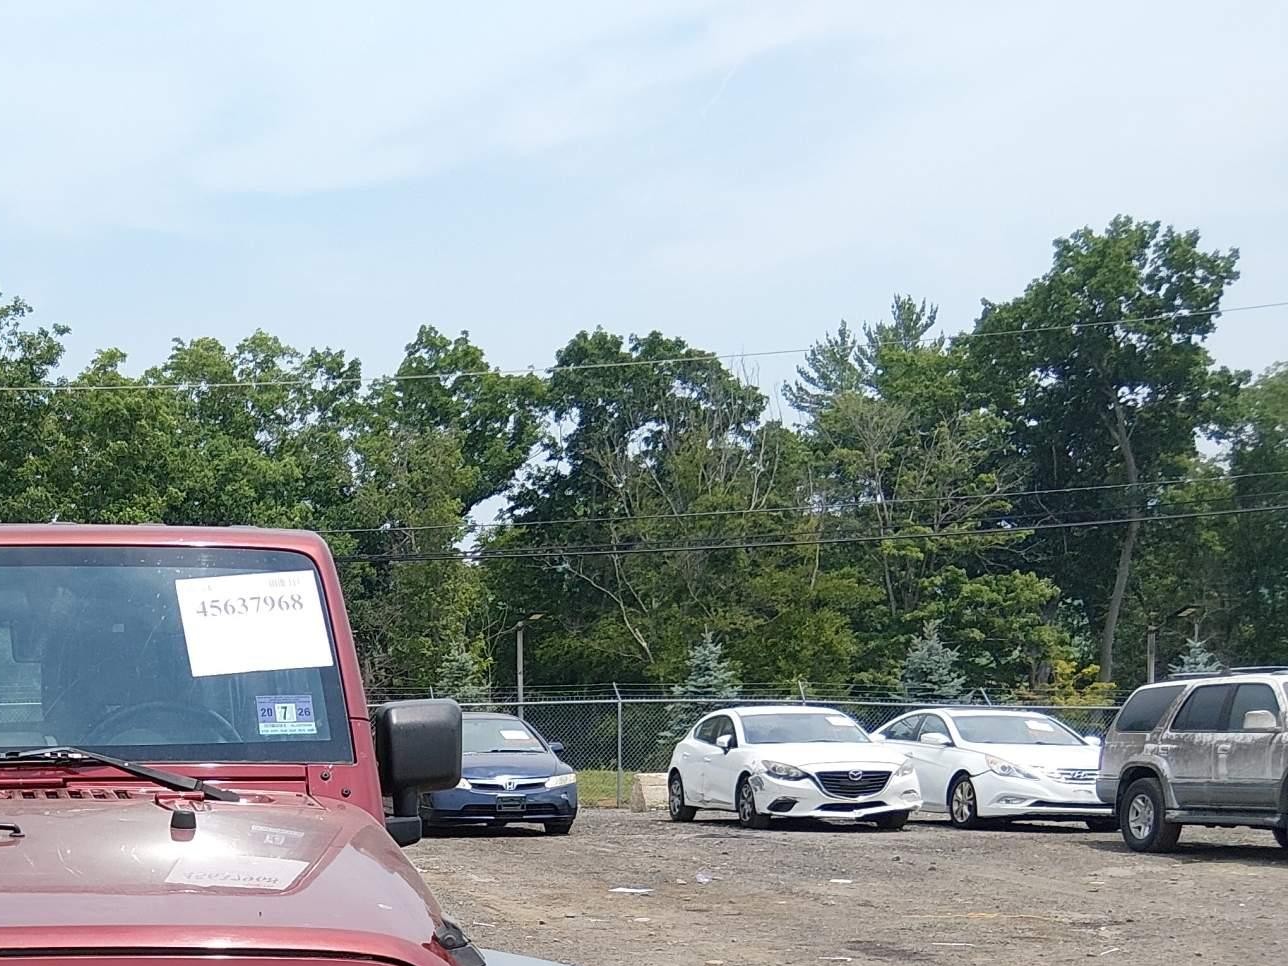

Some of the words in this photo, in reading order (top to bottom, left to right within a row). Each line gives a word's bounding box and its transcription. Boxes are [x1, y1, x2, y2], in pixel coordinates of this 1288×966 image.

[196, 593, 304, 617] 45637968
[260, 708, 273, 717] 20
[281, 706, 287, 720] 7
[297, 707, 311, 716] 26
